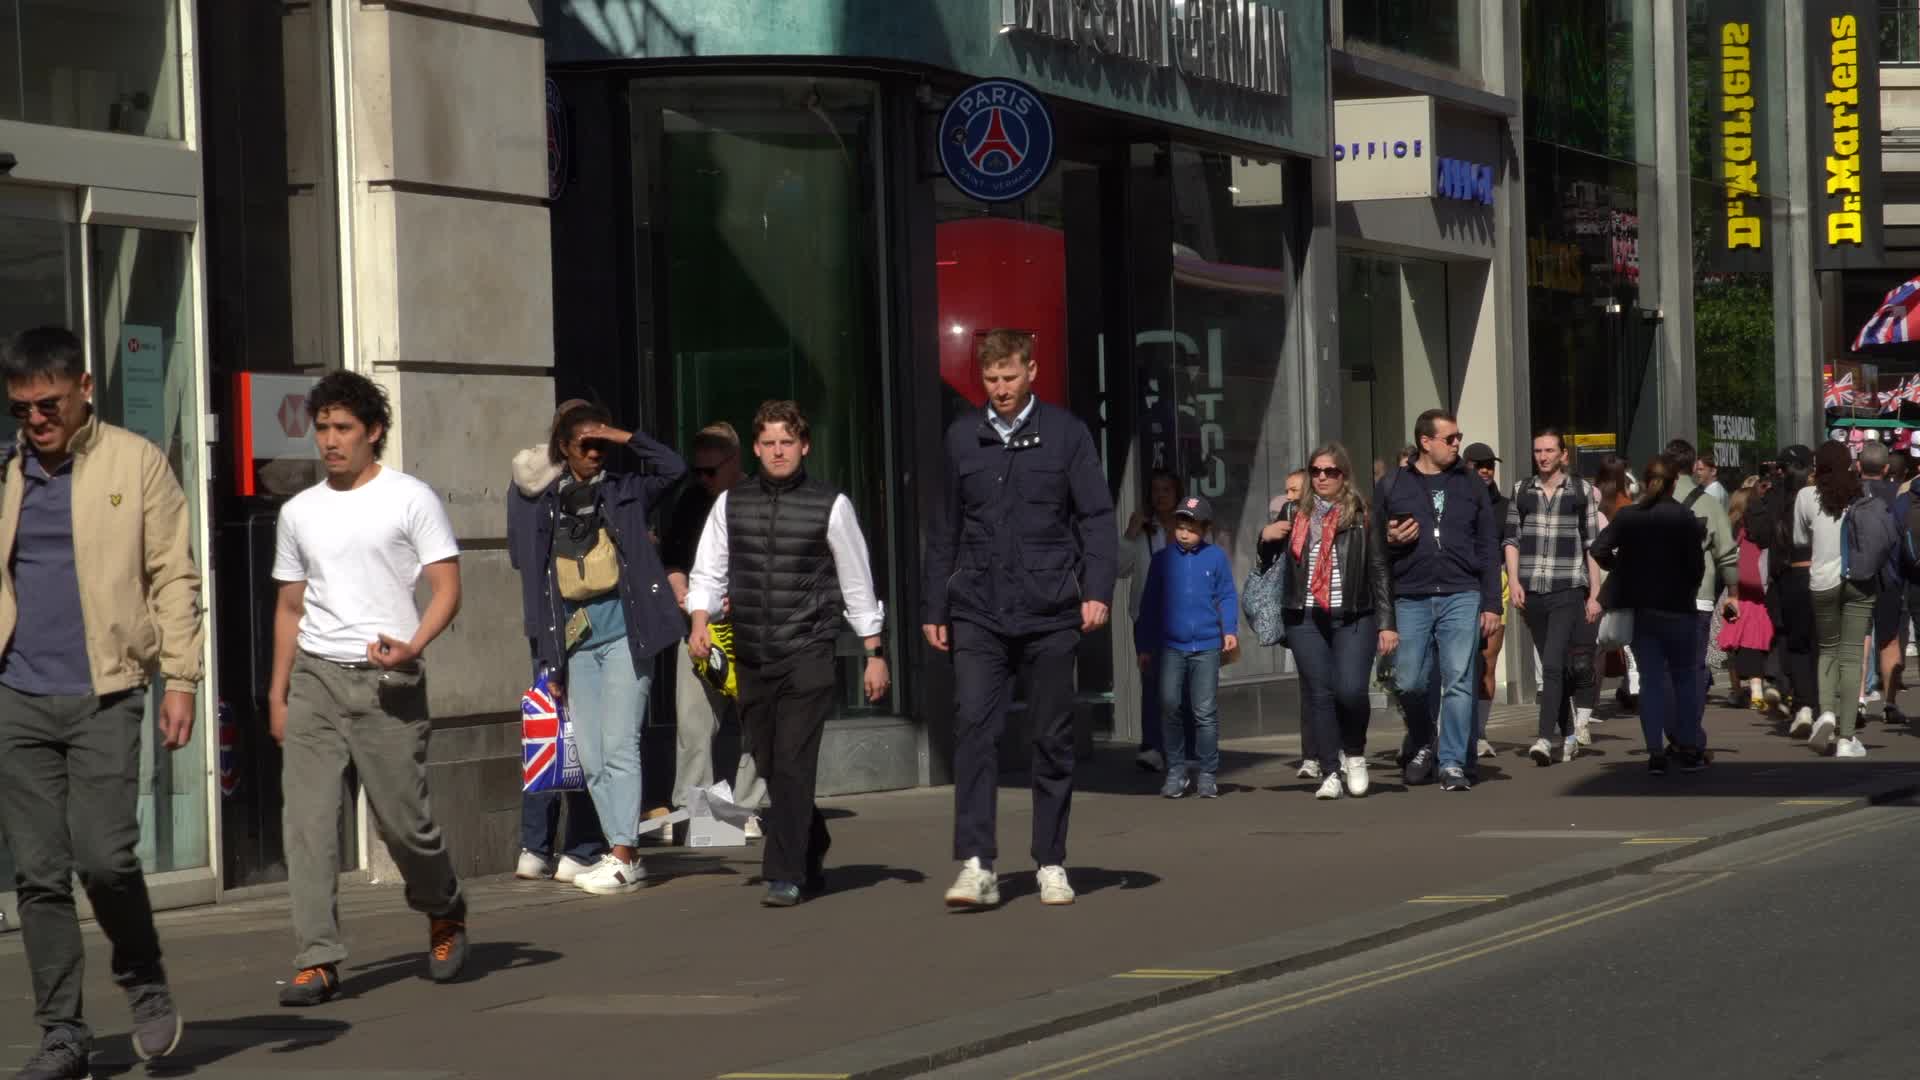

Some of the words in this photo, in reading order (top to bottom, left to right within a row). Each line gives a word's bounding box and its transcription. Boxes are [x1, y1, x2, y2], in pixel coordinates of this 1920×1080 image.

[959, 88, 1032, 115] PARIS
[1825, 15, 1860, 194] Martens
[1334, 140, 1422, 162] OFFICE
[1712, 415, 1726, 440] THE
